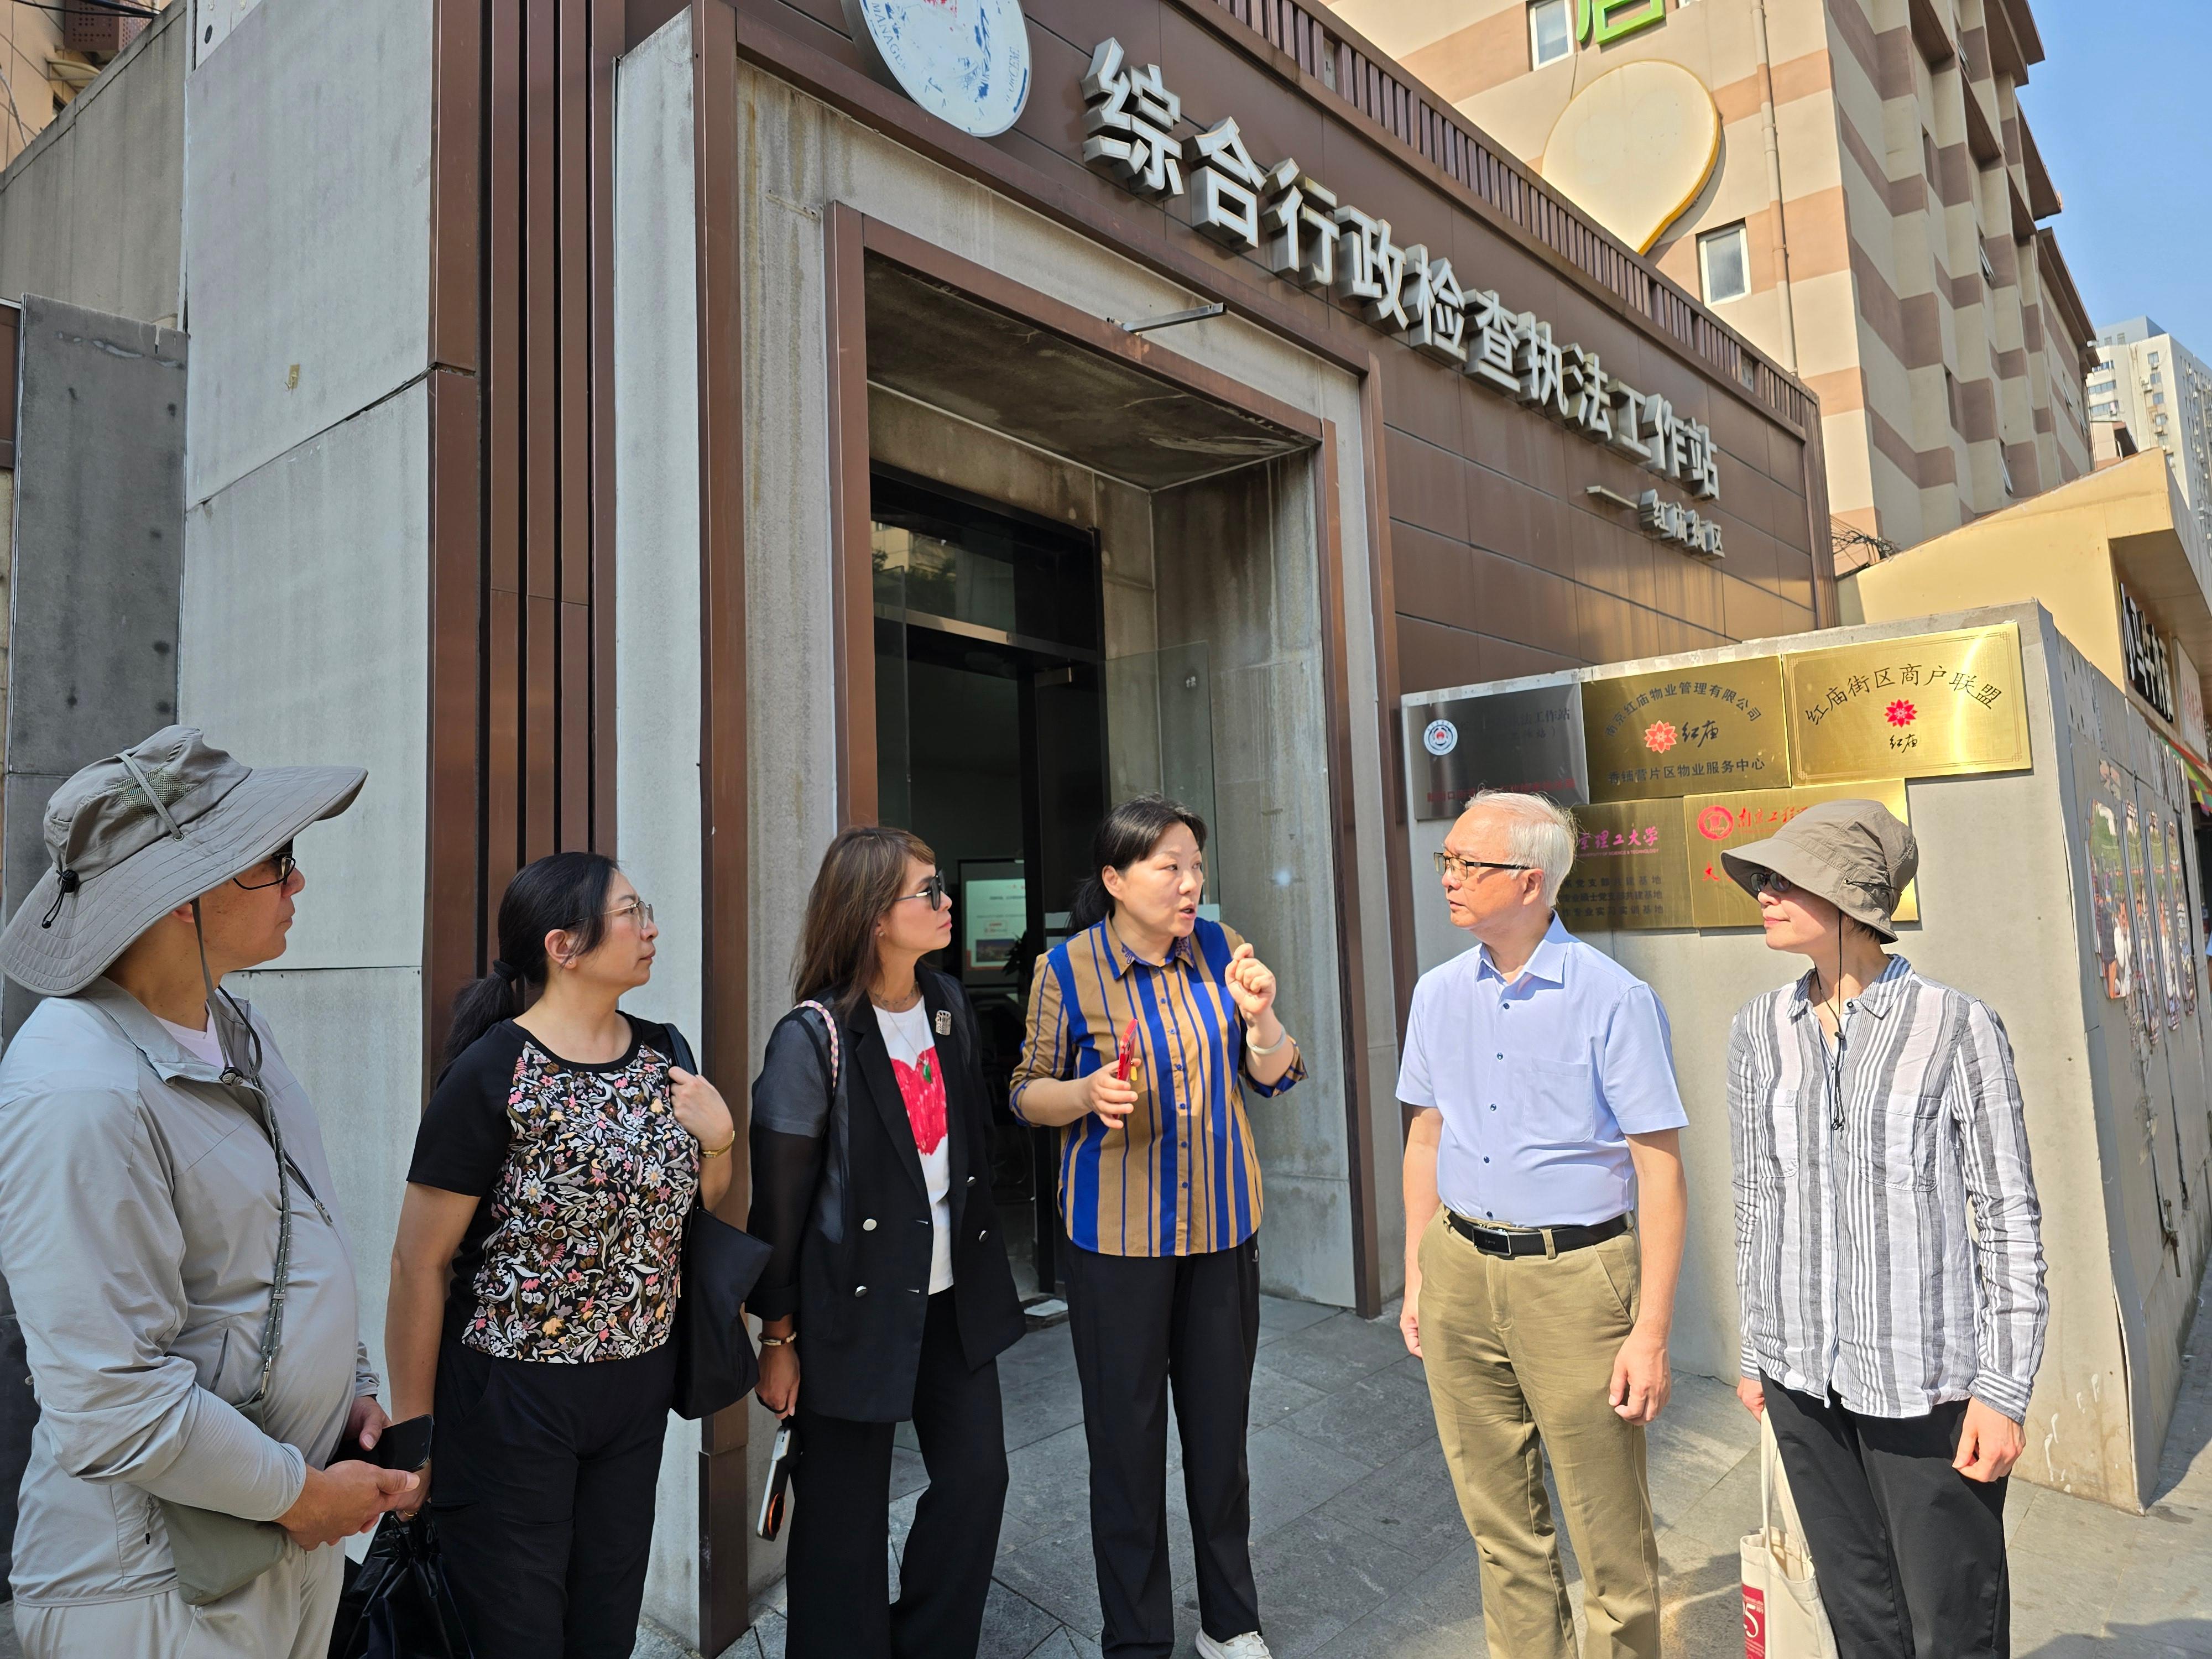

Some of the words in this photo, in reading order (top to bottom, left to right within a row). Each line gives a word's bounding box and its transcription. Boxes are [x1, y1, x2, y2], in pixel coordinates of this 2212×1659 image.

[1081, 36, 1720, 501] 综合行政检查执法工作站
[1605, 681, 1762, 738] 南京红庙物业管理有限公司
[1805, 663, 2002, 726] 红庙街区商户联盟
[1681, 719, 1720, 748] 红庙
[1889, 733, 1919, 754] 红庙
